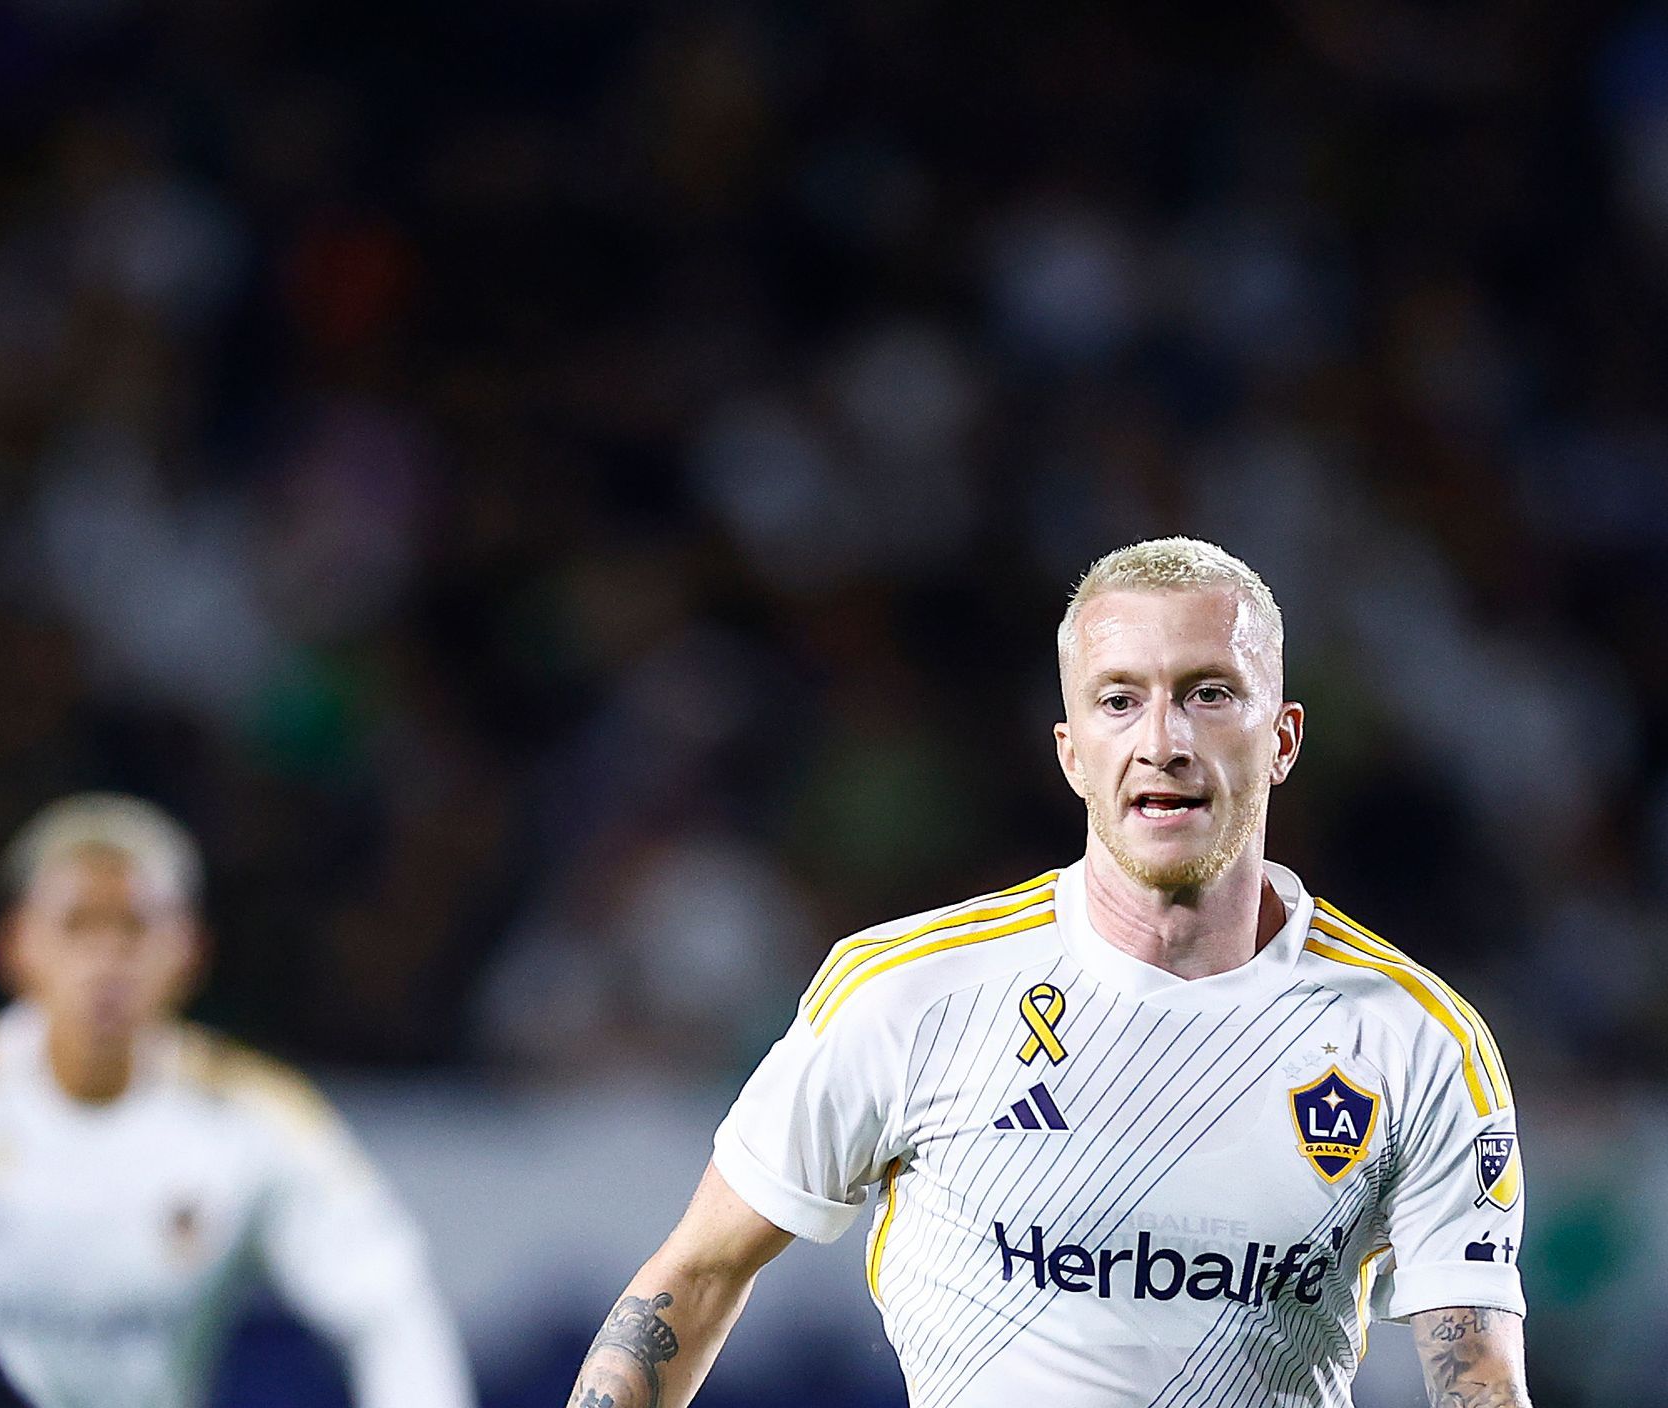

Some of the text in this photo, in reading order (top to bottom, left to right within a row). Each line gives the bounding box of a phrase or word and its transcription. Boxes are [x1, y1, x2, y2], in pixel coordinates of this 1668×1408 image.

[1308, 1107, 1358, 1139] LA
[1305, 1144, 1361, 1156] GALAXY
[1481, 1140, 1509, 1157] MLS
[992, 1221, 1329, 1306] Herbalife
